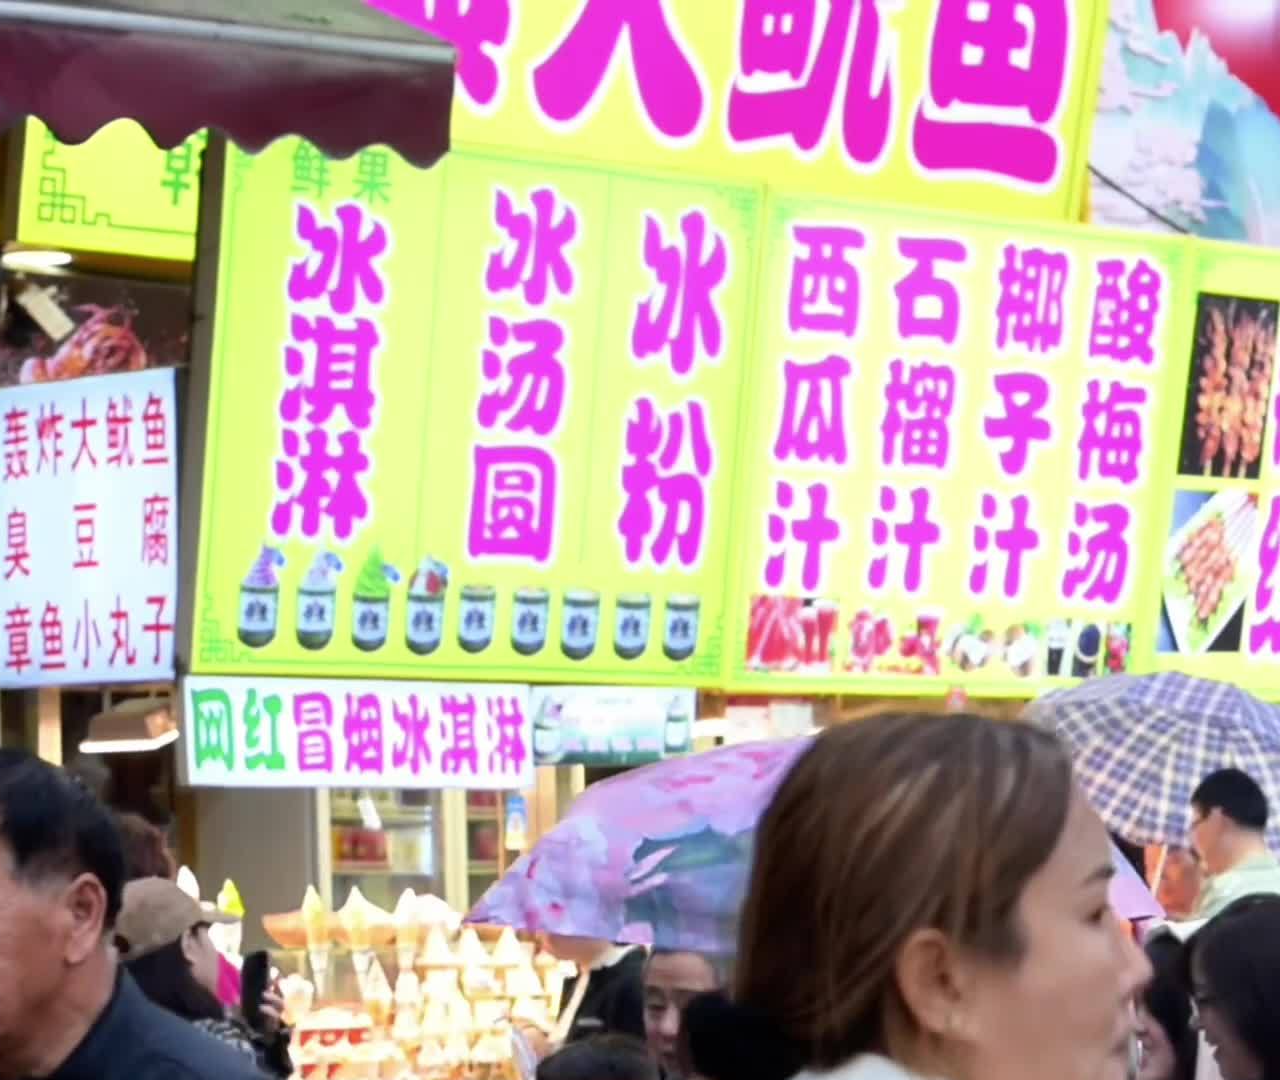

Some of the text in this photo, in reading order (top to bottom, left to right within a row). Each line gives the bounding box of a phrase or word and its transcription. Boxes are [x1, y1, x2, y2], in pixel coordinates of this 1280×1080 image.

[372, 0, 1058, 186] 大鱿鱼
[3, 392, 169, 482] 轰炸大鱿鱼
[272, 203, 388, 538] 冰淇淋
[468, 188, 576, 562] 冰汤圆
[618, 210, 727, 565] 冰粉
[765, 225, 866, 592] 西瓜汁
[868, 236, 968, 593] 石榴汁
[969, 245, 1070, 598] 椰子汁
[1061, 258, 1162, 604] 酸梅汤
[4, 594, 174, 674] 章鱼小丸子
[191, 687, 526, 775] 网红冒烟冰淇淋
